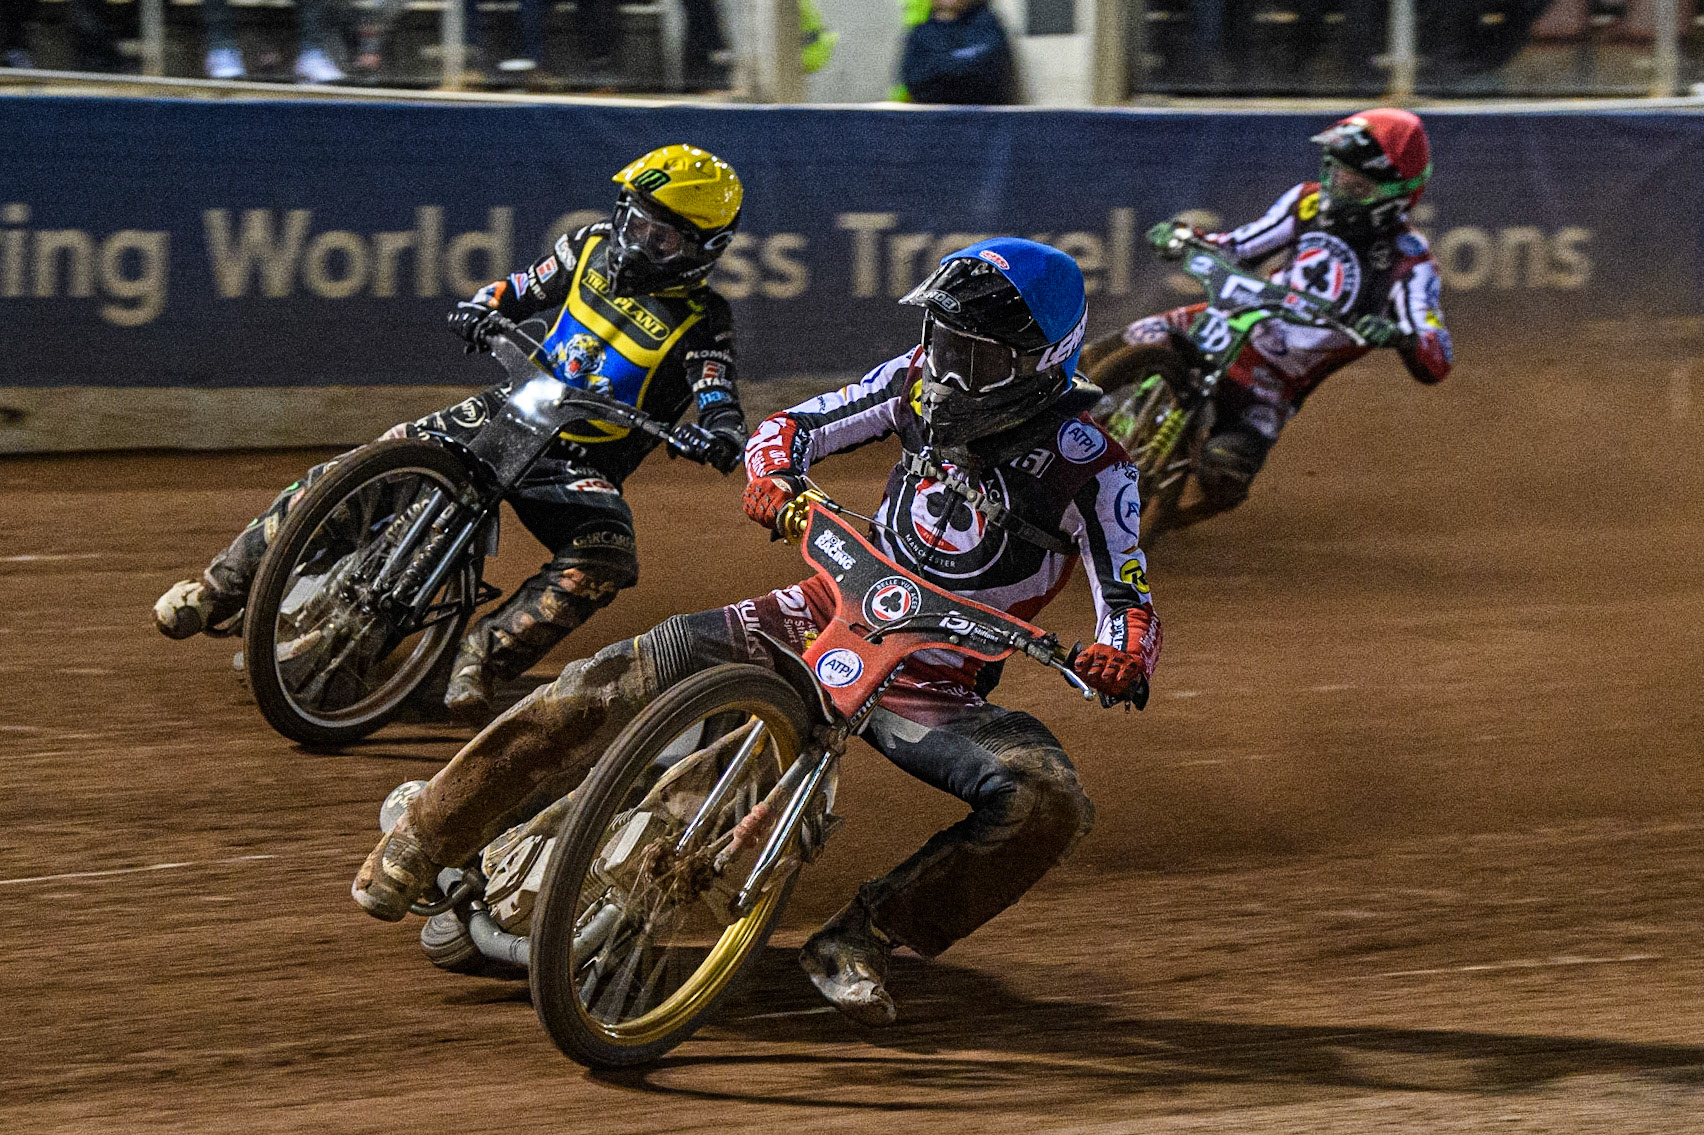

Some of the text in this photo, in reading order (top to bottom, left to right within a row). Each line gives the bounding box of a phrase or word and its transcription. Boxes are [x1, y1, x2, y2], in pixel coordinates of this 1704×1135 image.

[205, 205, 515, 299] World
[836, 206, 1135, 298] Trel
[1068, 426, 1097, 453] ATPI
[813, 536, 854, 570] RACING
[876, 579, 918, 610] BELLE VUE ACES
[783, 617, 799, 644] Sport
[824, 658, 854, 678] ATPI
